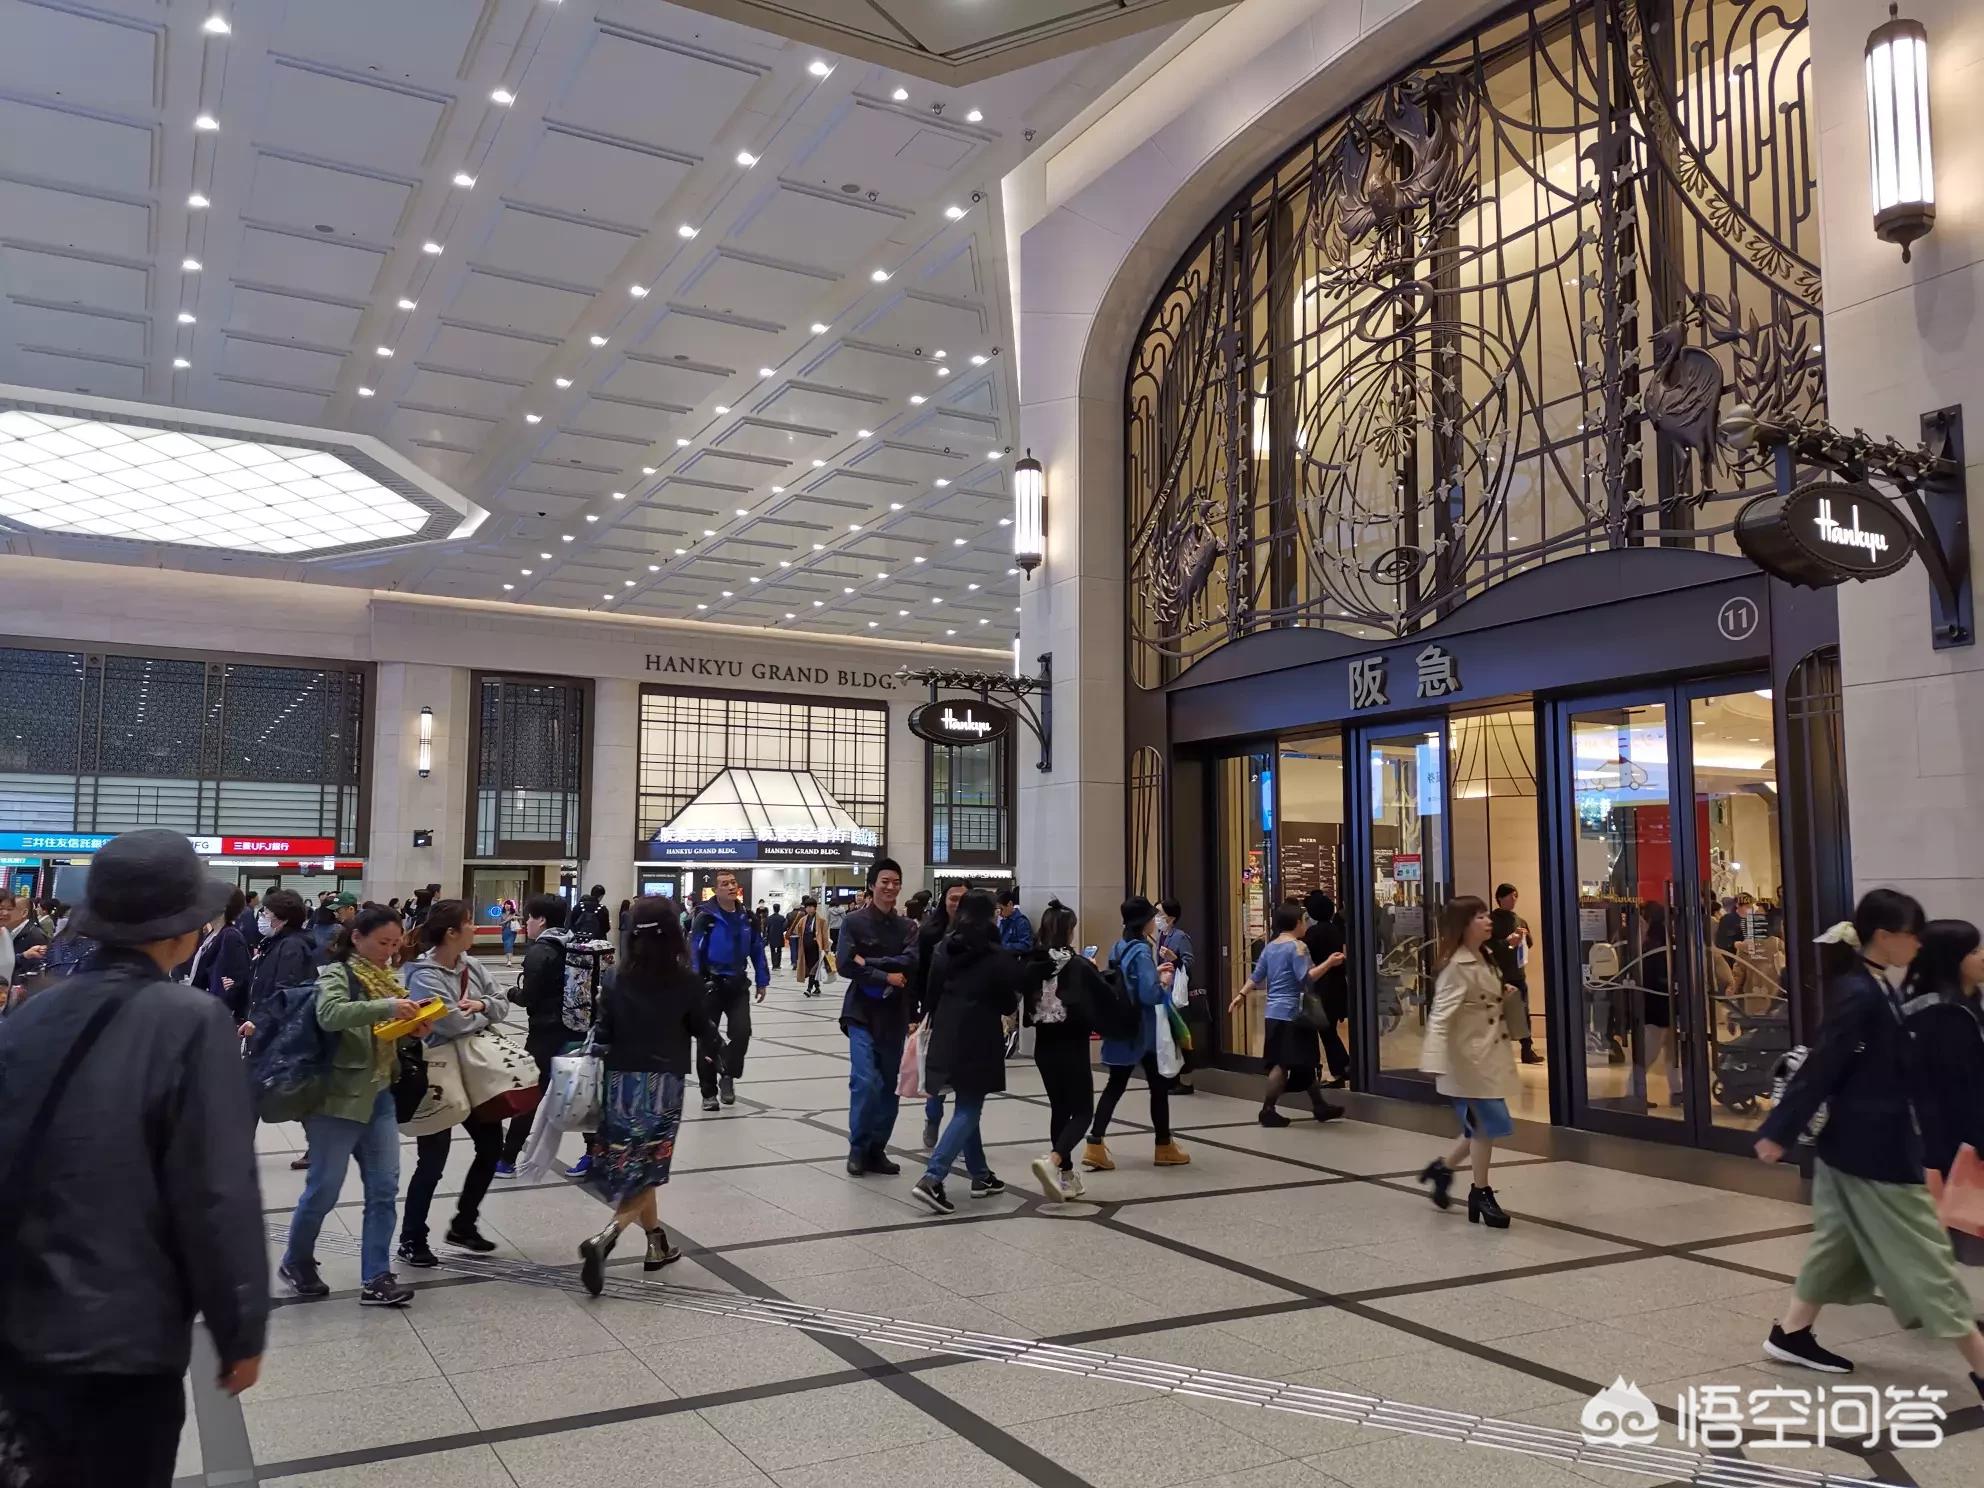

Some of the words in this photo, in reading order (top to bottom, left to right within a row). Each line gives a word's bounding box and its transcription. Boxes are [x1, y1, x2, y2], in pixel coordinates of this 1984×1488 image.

[1813, 498, 1889, 563] Hankyu
[1724, 607, 1749, 631] 11
[645, 654, 743, 677] HANKYU
[751, 662, 829, 684] GRAND
[837, 670, 897, 690] BLDG.
[1348, 644, 1461, 710] 阪急
[941, 708, 992, 737] Hankyu
[666, 847, 693, 855] HANKYU
[694, 847, 717, 855] GRAND
[765, 847, 793, 855] HANKYU
[820, 848, 841, 856] BLDG.
